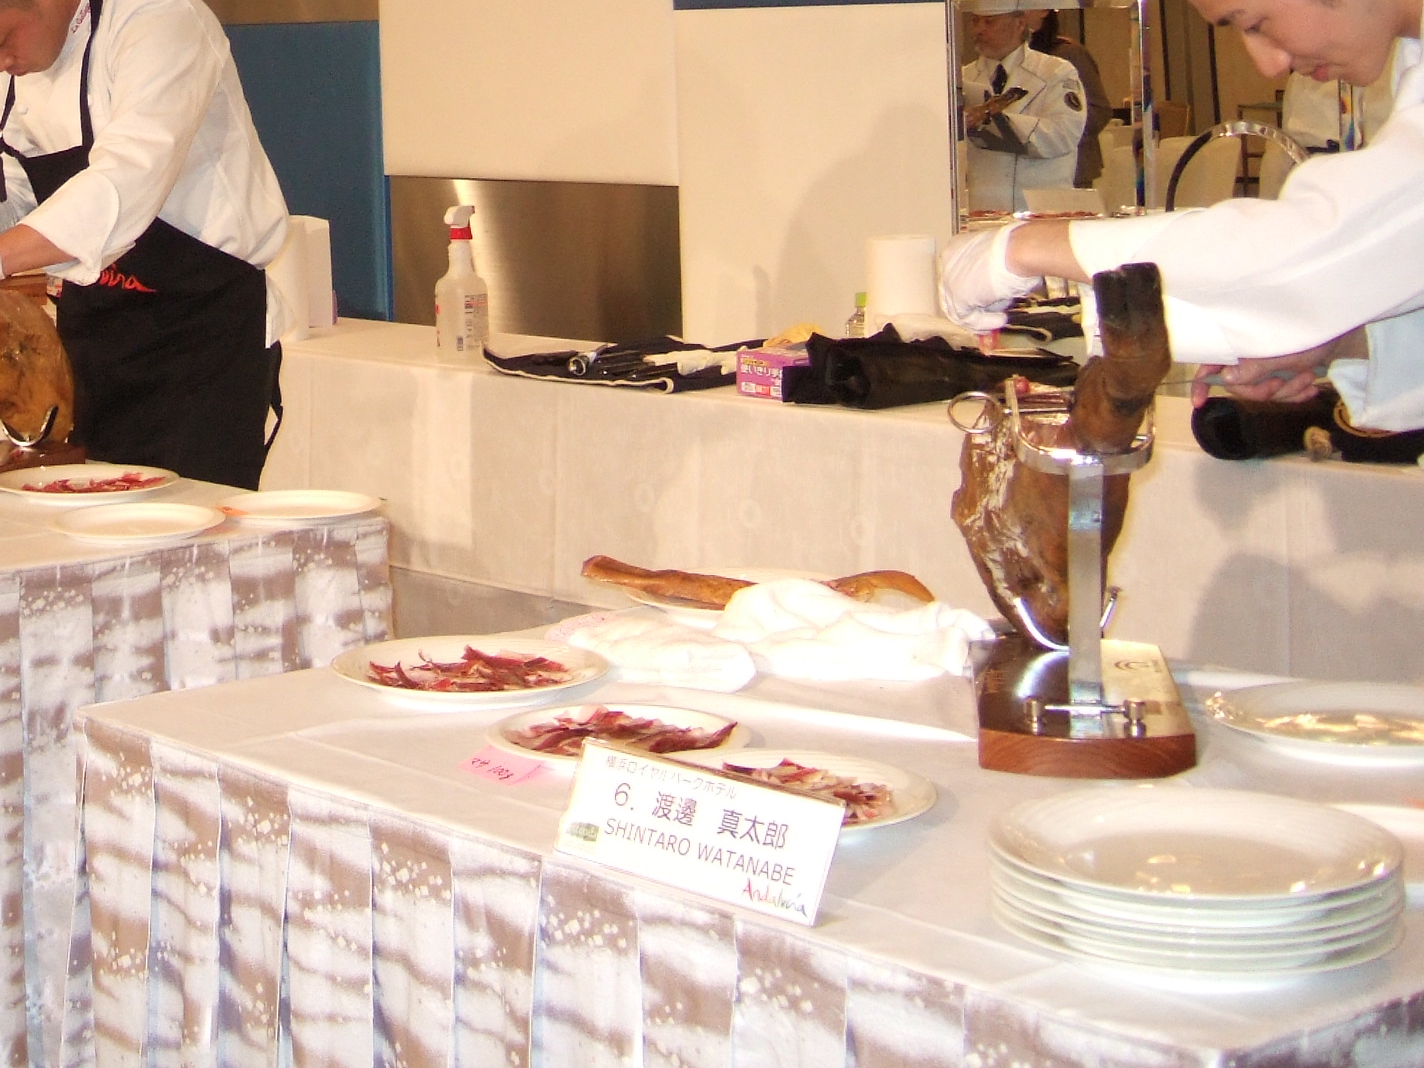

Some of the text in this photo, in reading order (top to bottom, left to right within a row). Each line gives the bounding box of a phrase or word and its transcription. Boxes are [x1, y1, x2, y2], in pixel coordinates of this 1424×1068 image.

[604, 818, 796, 886] SHINTARO WATANABE
[717, 808, 789, 850] 真太郎
